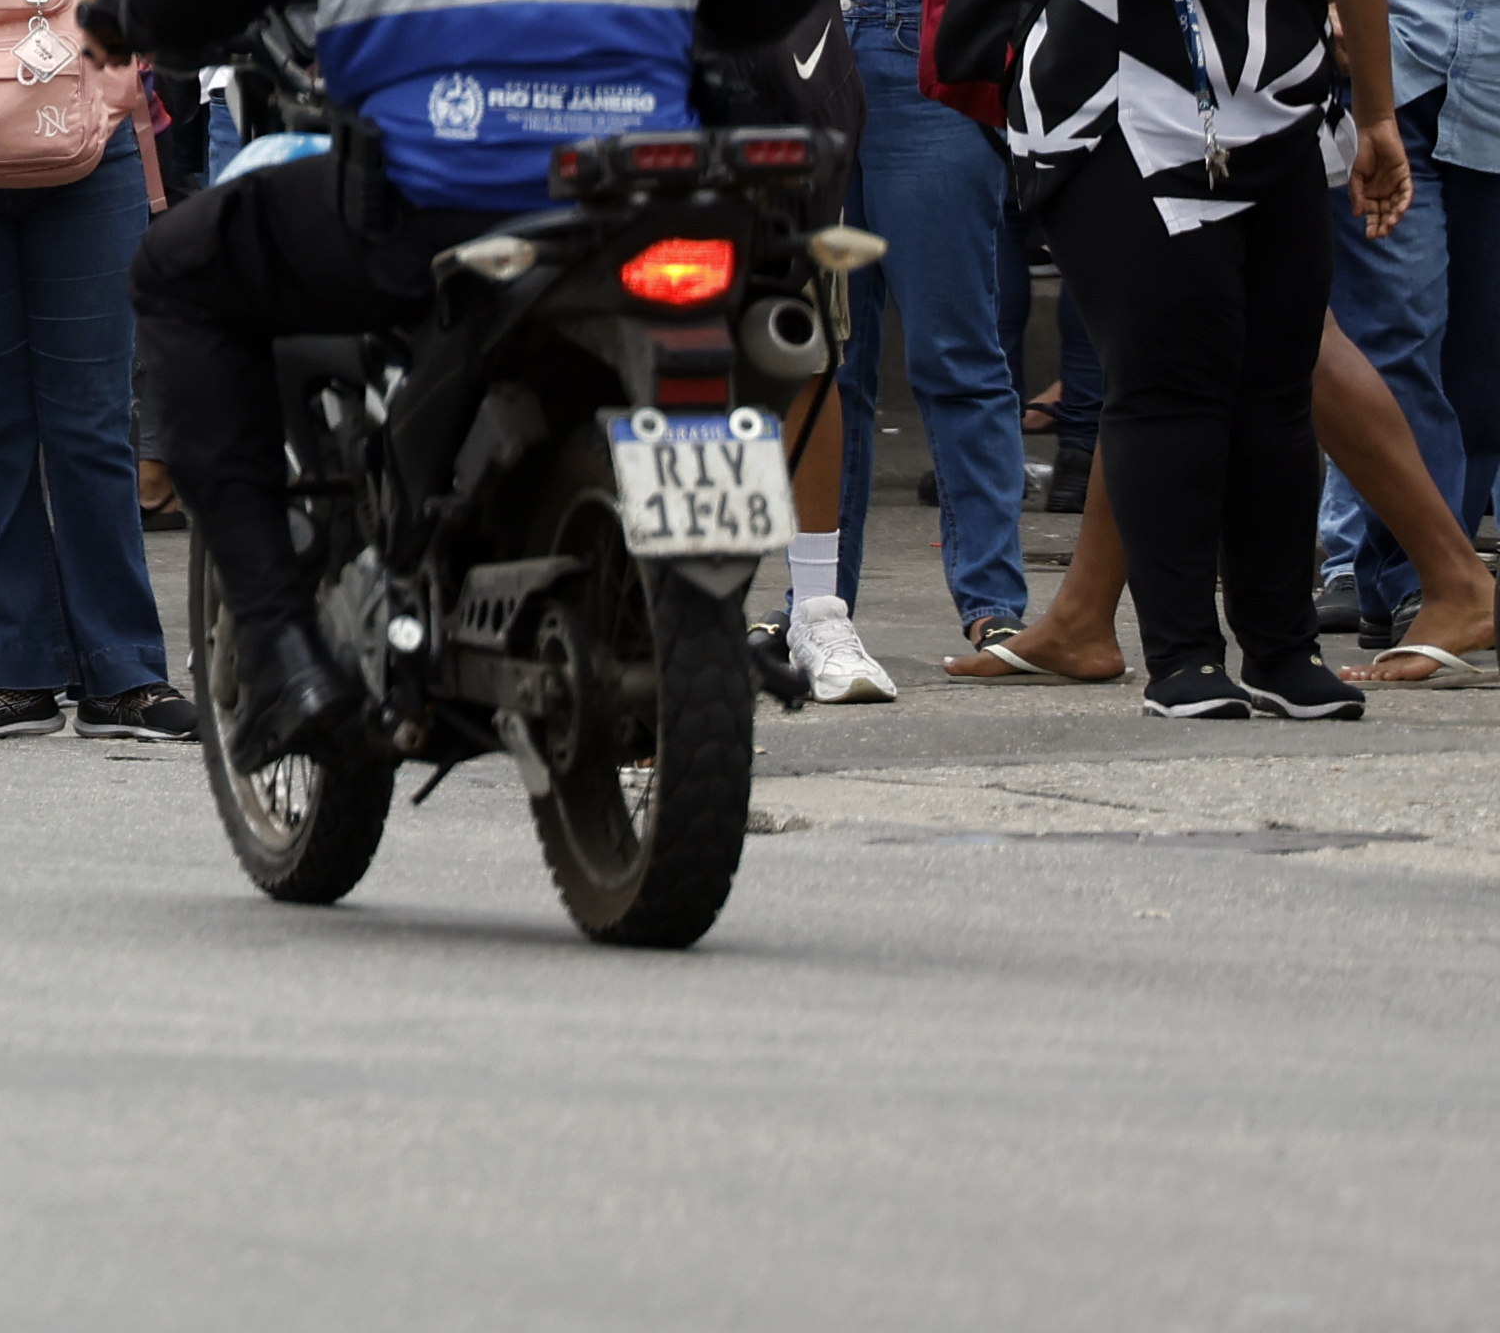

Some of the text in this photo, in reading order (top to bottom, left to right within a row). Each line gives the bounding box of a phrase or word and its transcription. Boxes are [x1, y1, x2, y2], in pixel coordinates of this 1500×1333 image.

[488, 88, 655, 114] RIO DE JANEIRO
[655, 443, 743, 487] RIY
[645, 492, 772, 540] 1I48
